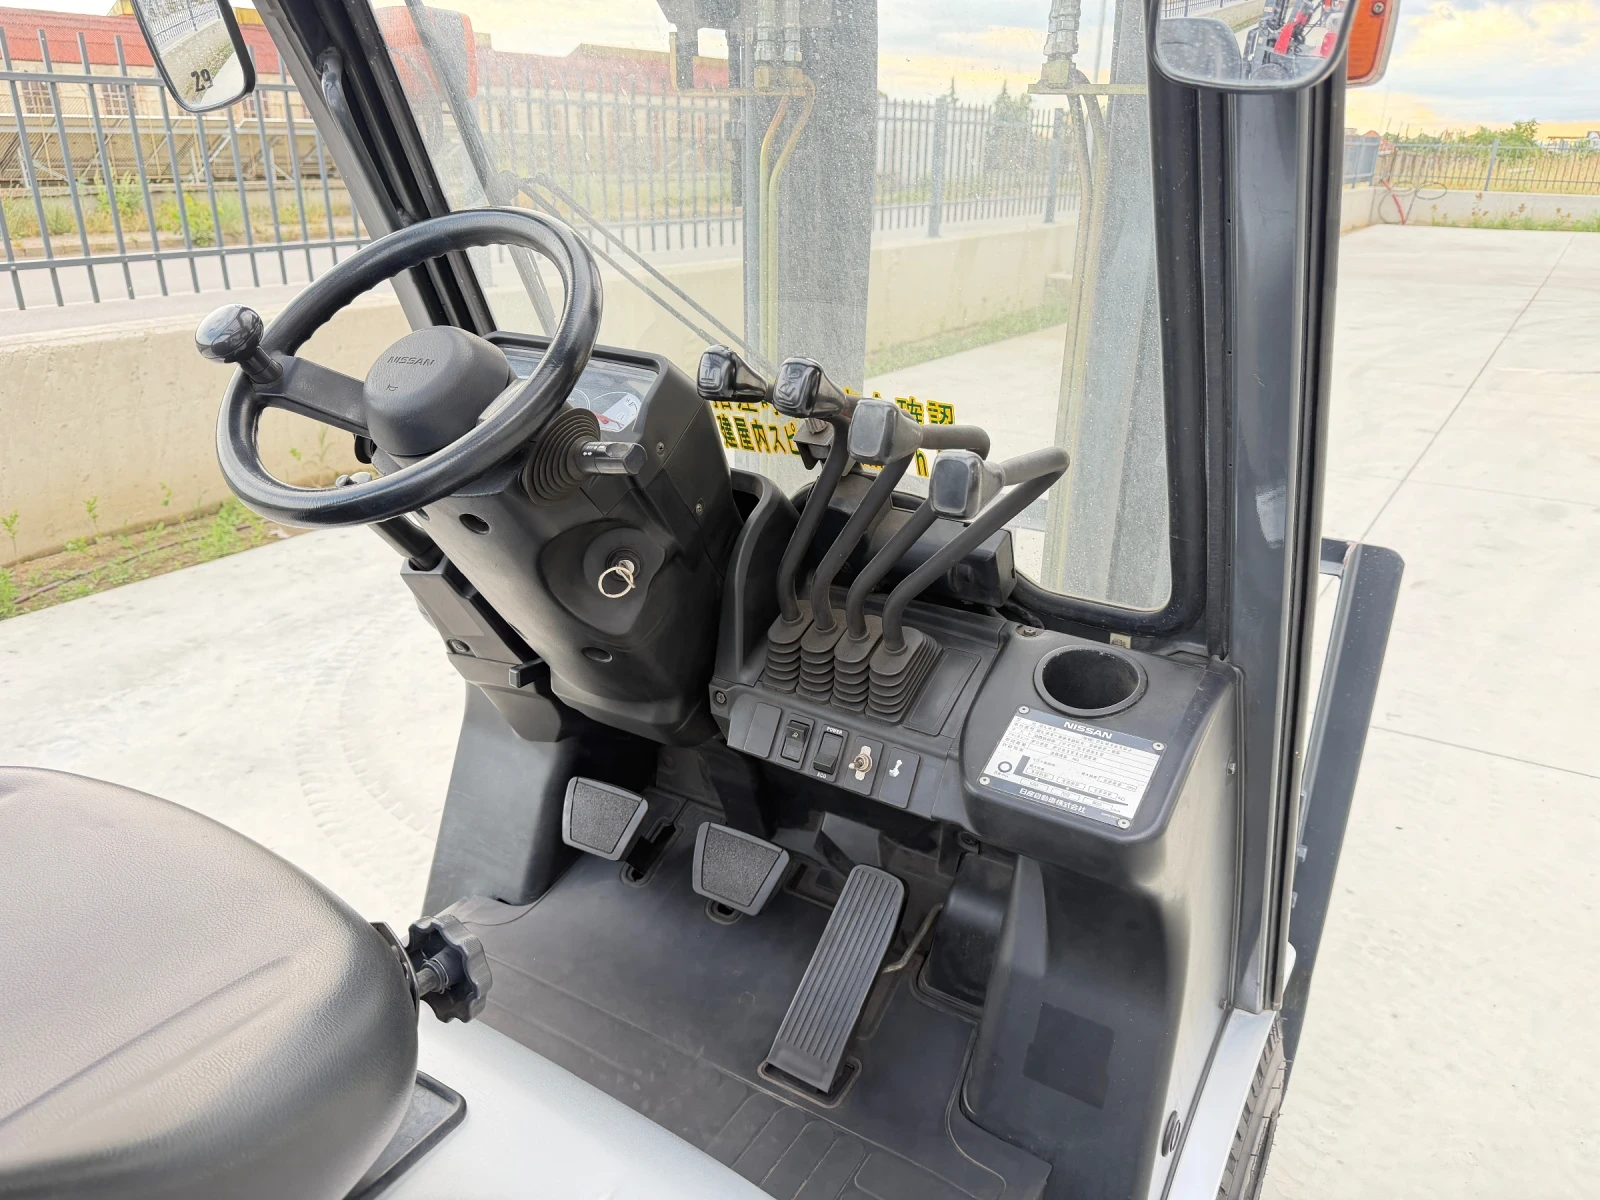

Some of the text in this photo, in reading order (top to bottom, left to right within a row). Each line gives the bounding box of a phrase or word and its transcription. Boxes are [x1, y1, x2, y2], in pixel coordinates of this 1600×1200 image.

[190, 68, 213, 92] 29
[386, 356, 436, 367] NISSAN
[826, 726, 843, 735] POWER
[1063, 721, 1113, 740] NISSAN
